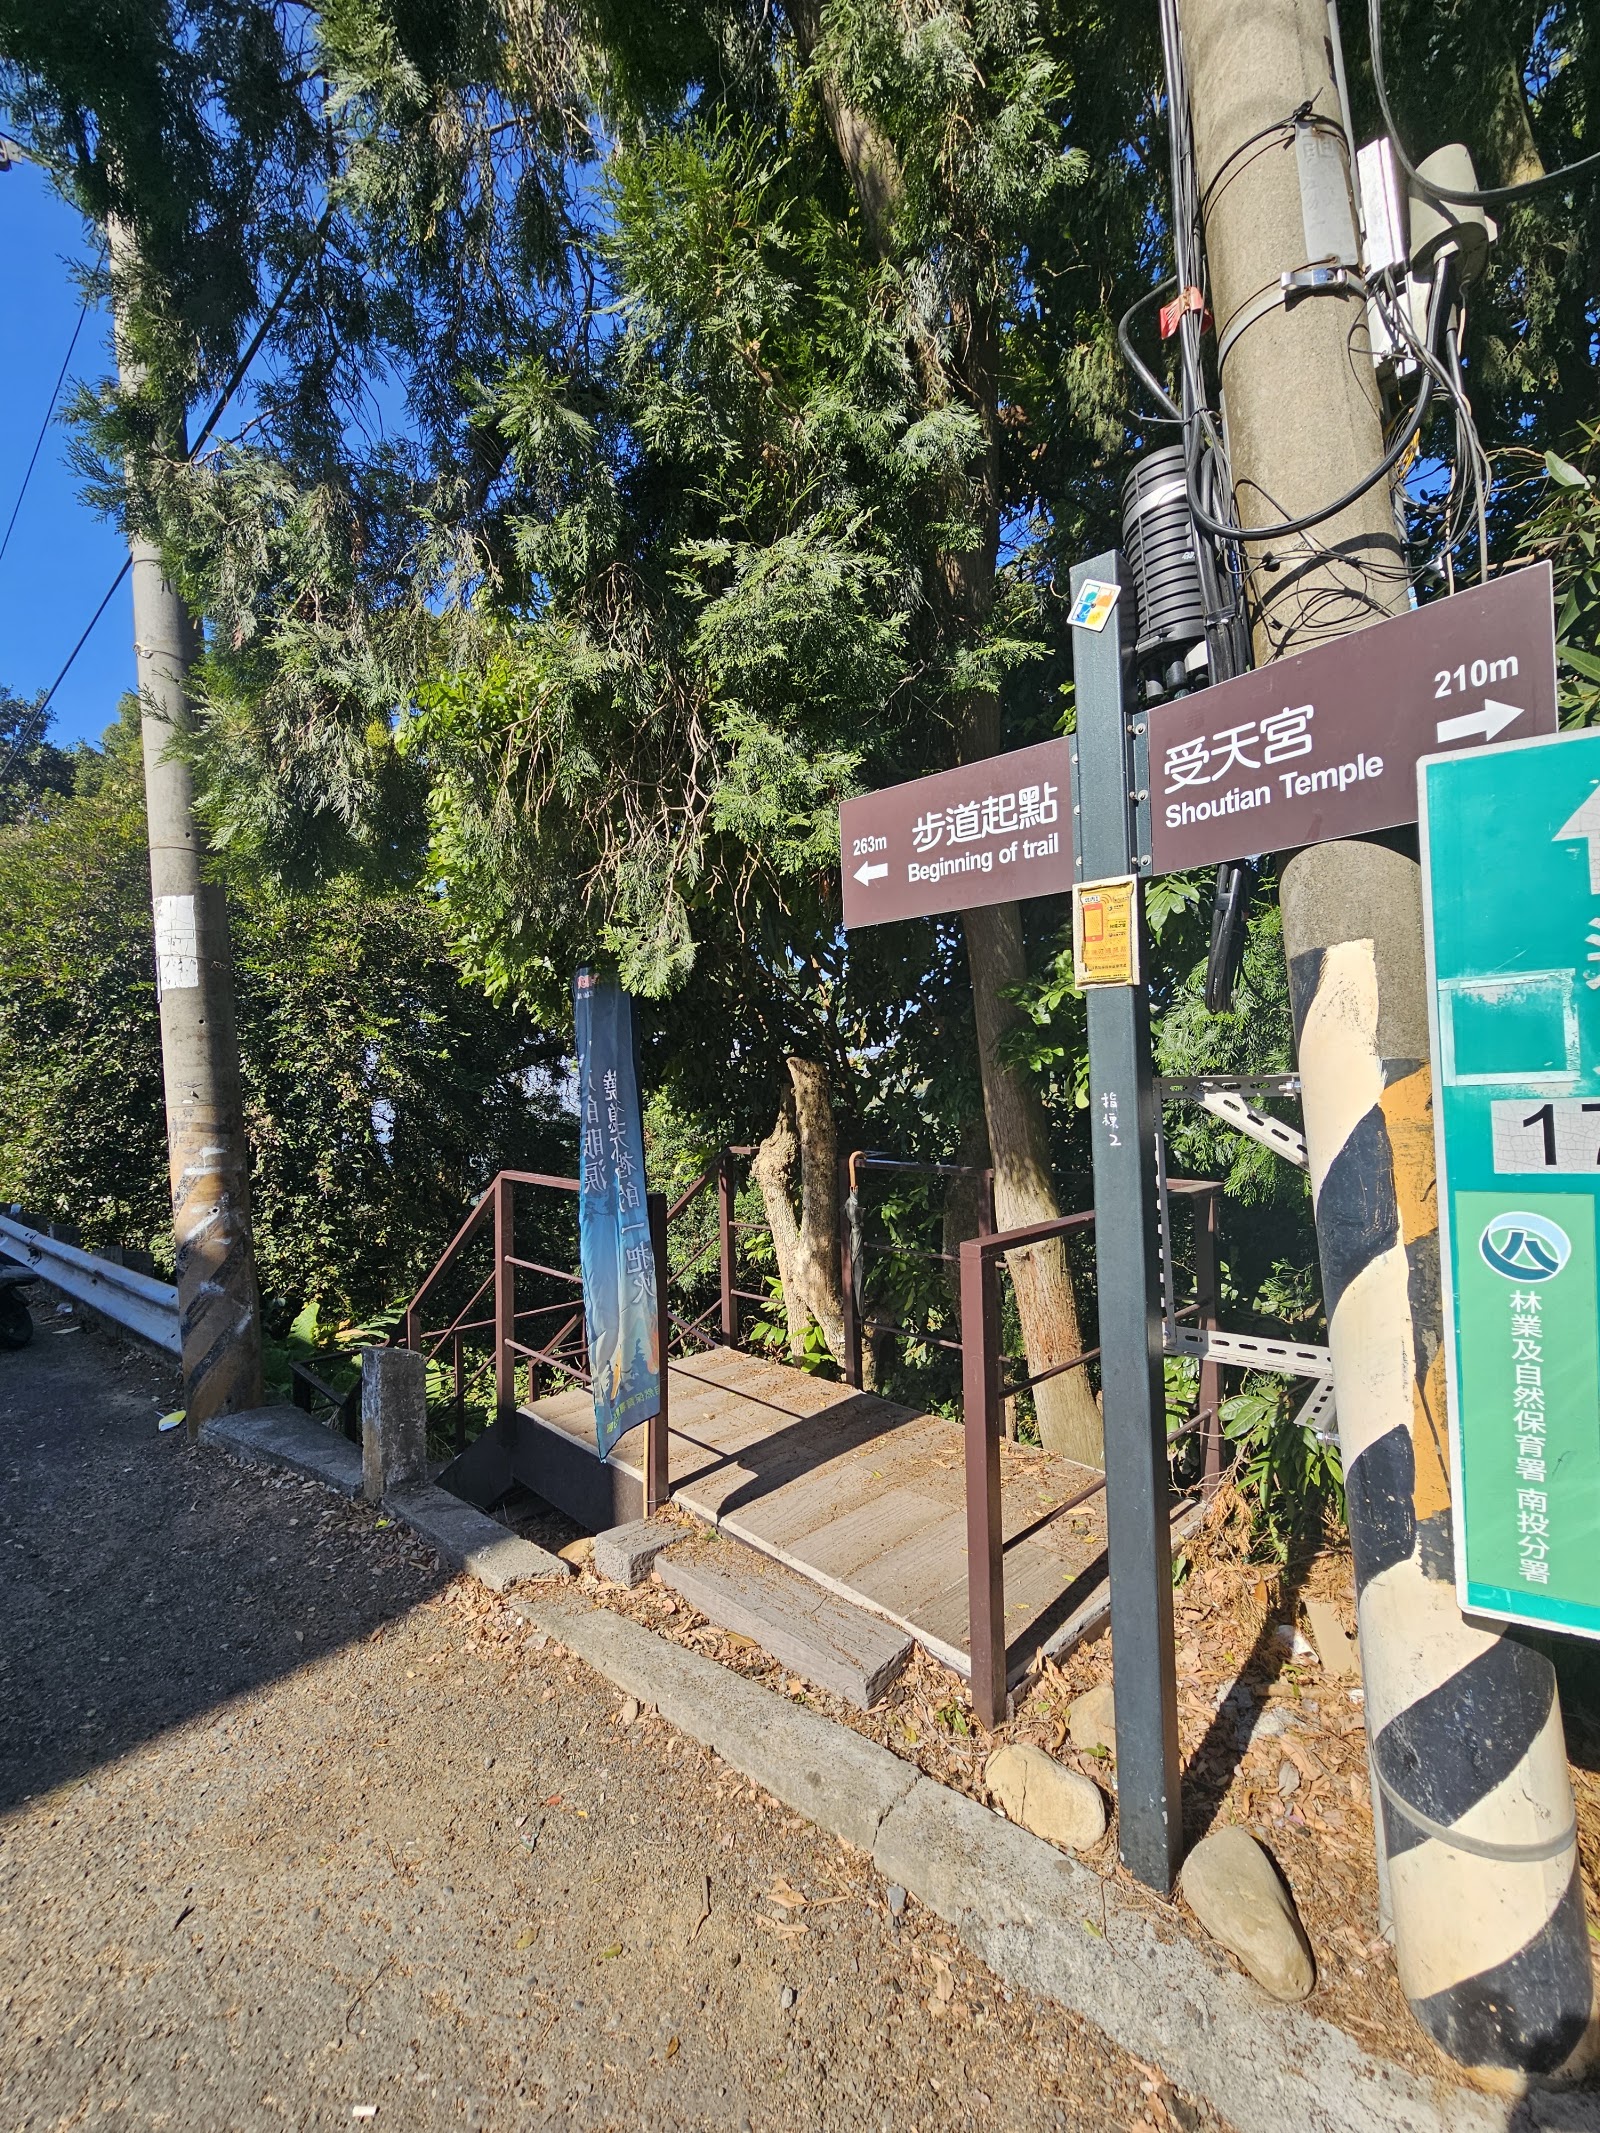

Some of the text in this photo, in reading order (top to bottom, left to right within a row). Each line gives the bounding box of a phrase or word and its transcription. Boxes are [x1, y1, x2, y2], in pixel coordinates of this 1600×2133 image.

[1433, 655, 1519, 699] 210m
[1163, 704, 1315, 795] 受天宮
[911, 781, 1058, 853] 步道起點
[1165, 753, 1384, 828] Shoutian Temple
[852, 835, 887, 856] 263m
[907, 832, 1060, 883] Beginning of trail
[1509, 1289, 1551, 1585] 林業及自然保育署 南投分署
